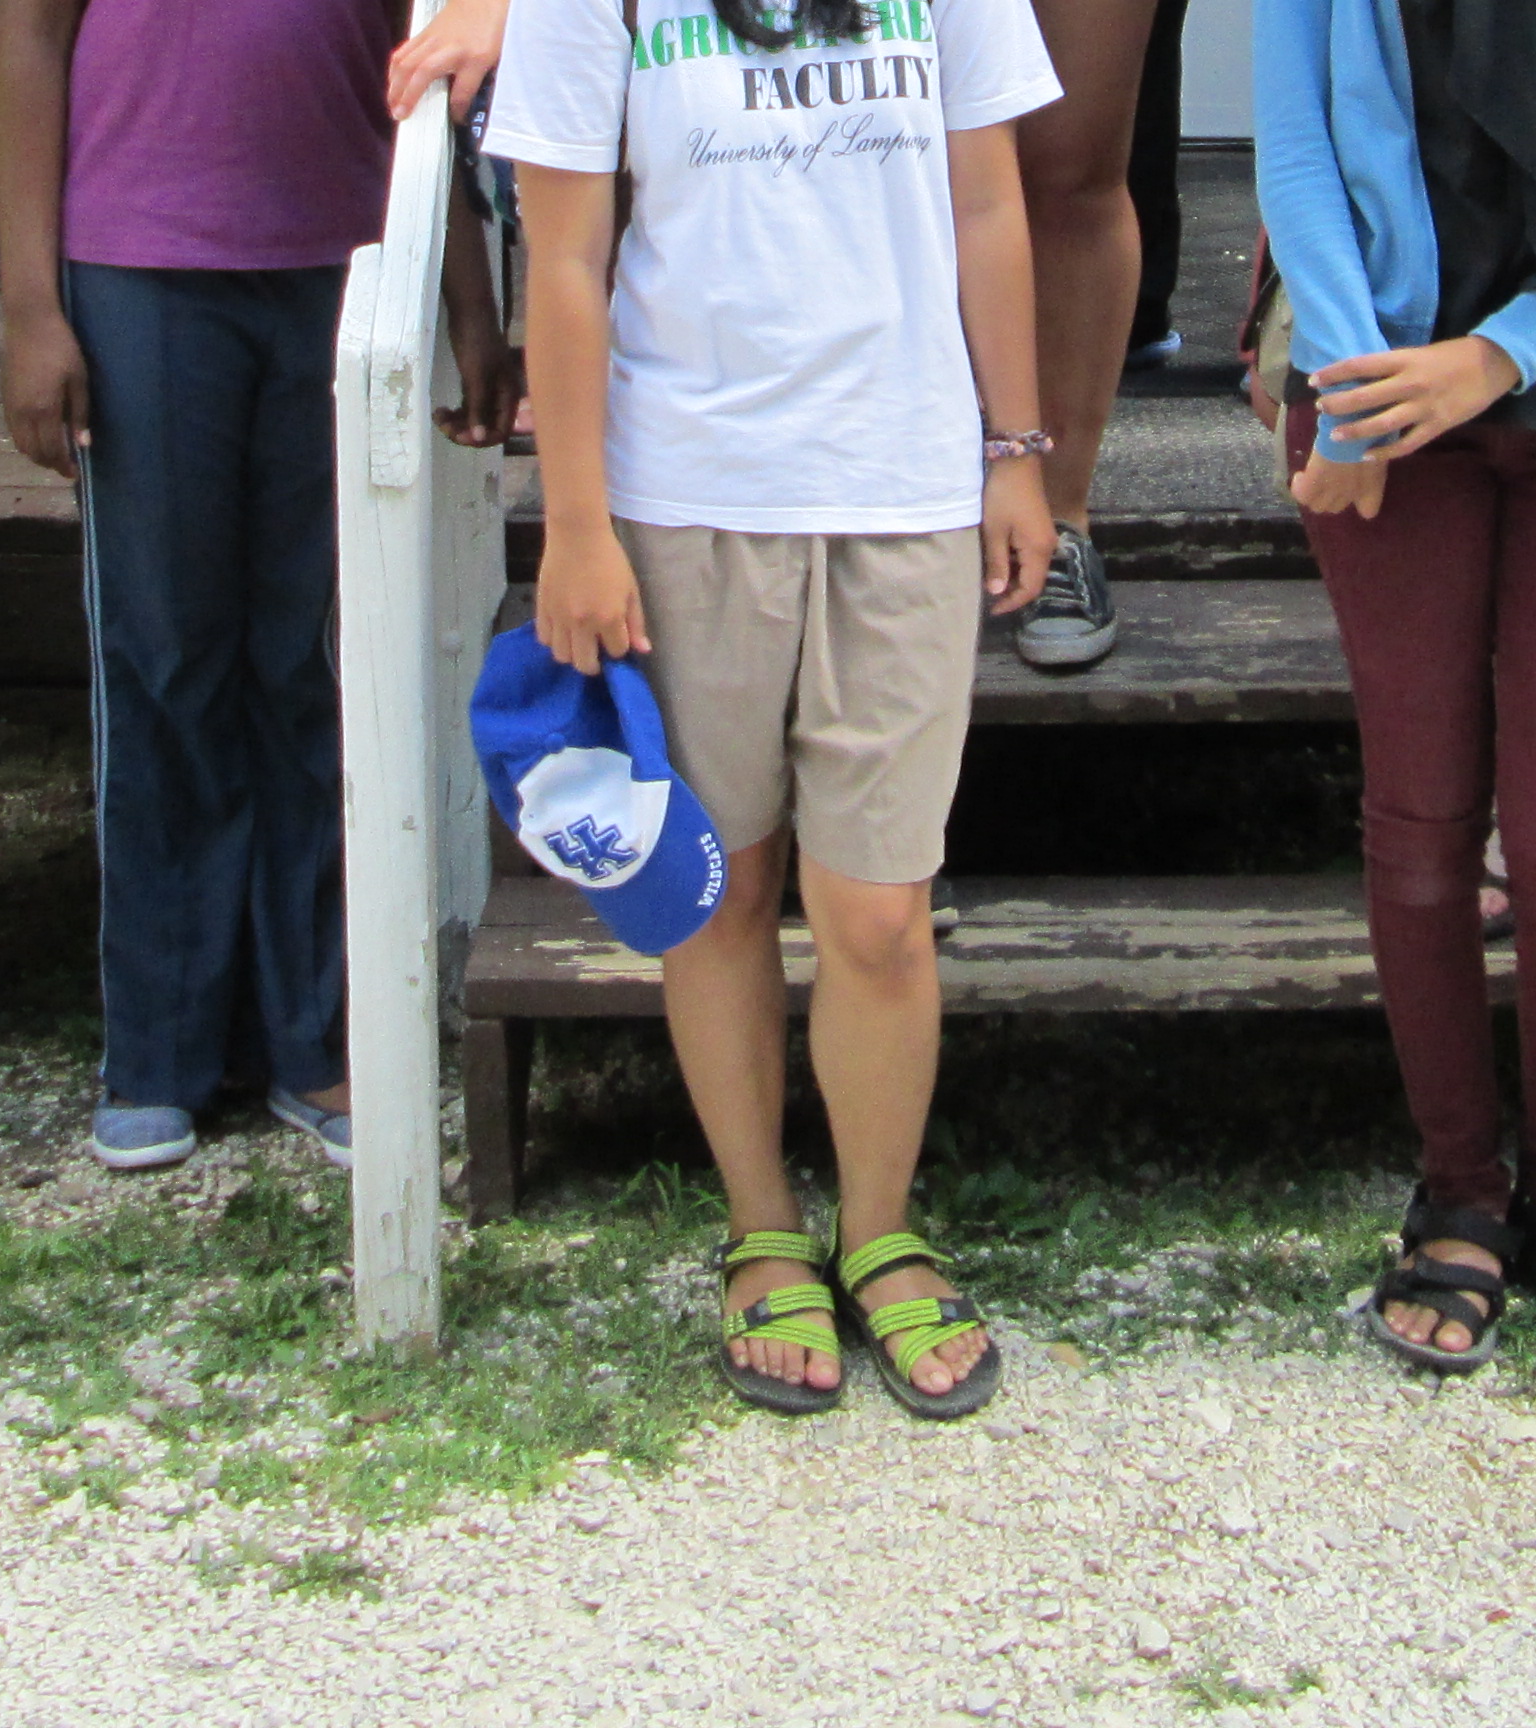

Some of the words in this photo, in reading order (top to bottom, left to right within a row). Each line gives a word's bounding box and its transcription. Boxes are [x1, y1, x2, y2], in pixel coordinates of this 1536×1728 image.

[632, 0, 933, 70] AGRIRE
[740, 55, 933, 110] FACULTY
[687, 127, 798, 178] University
[802, 121, 838, 172] of
[544, 814, 641, 880] UK
[696, 831, 724, 908] WILDCATS
